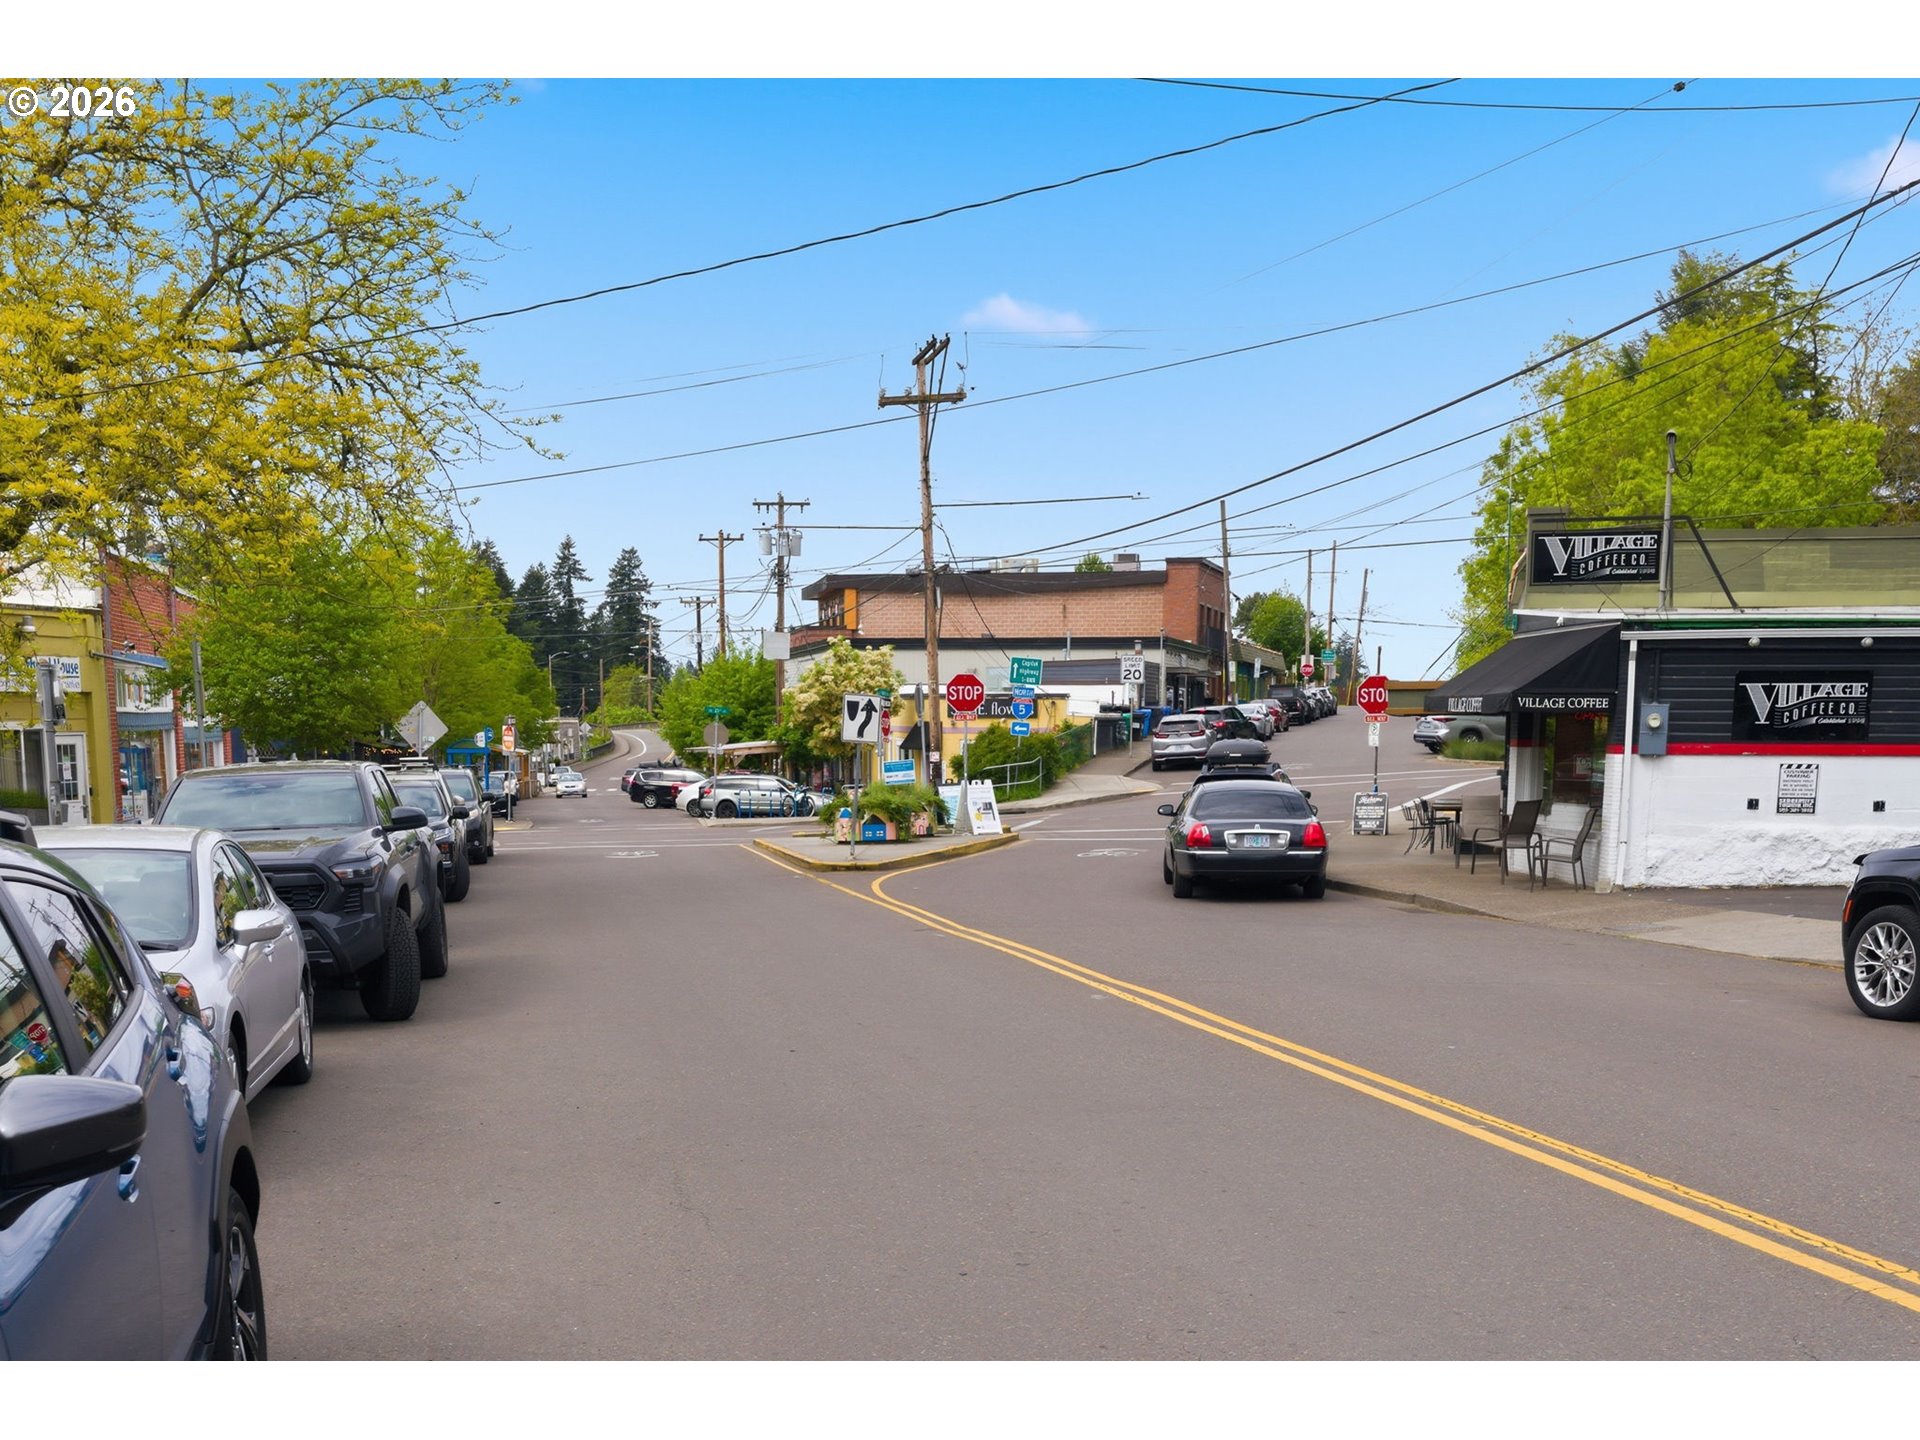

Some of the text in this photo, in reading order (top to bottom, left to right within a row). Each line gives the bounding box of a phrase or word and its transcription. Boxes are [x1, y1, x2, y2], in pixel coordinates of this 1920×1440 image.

[1538, 535, 1658, 576] VILLAGE
[1580, 553, 1648, 575] COFFEE CO.
[1123, 669, 1142, 680] 20
[949, 686, 982, 700] STOP
[1014, 688, 1034, 697] NORTH
[1019, 704, 1026, 715] 5
[1518, 697, 1609, 709] VILLAGE COFFEE
[1739, 682, 1868, 724] VILLAGE
[1783, 702, 1857, 724] COFFEE CO.
